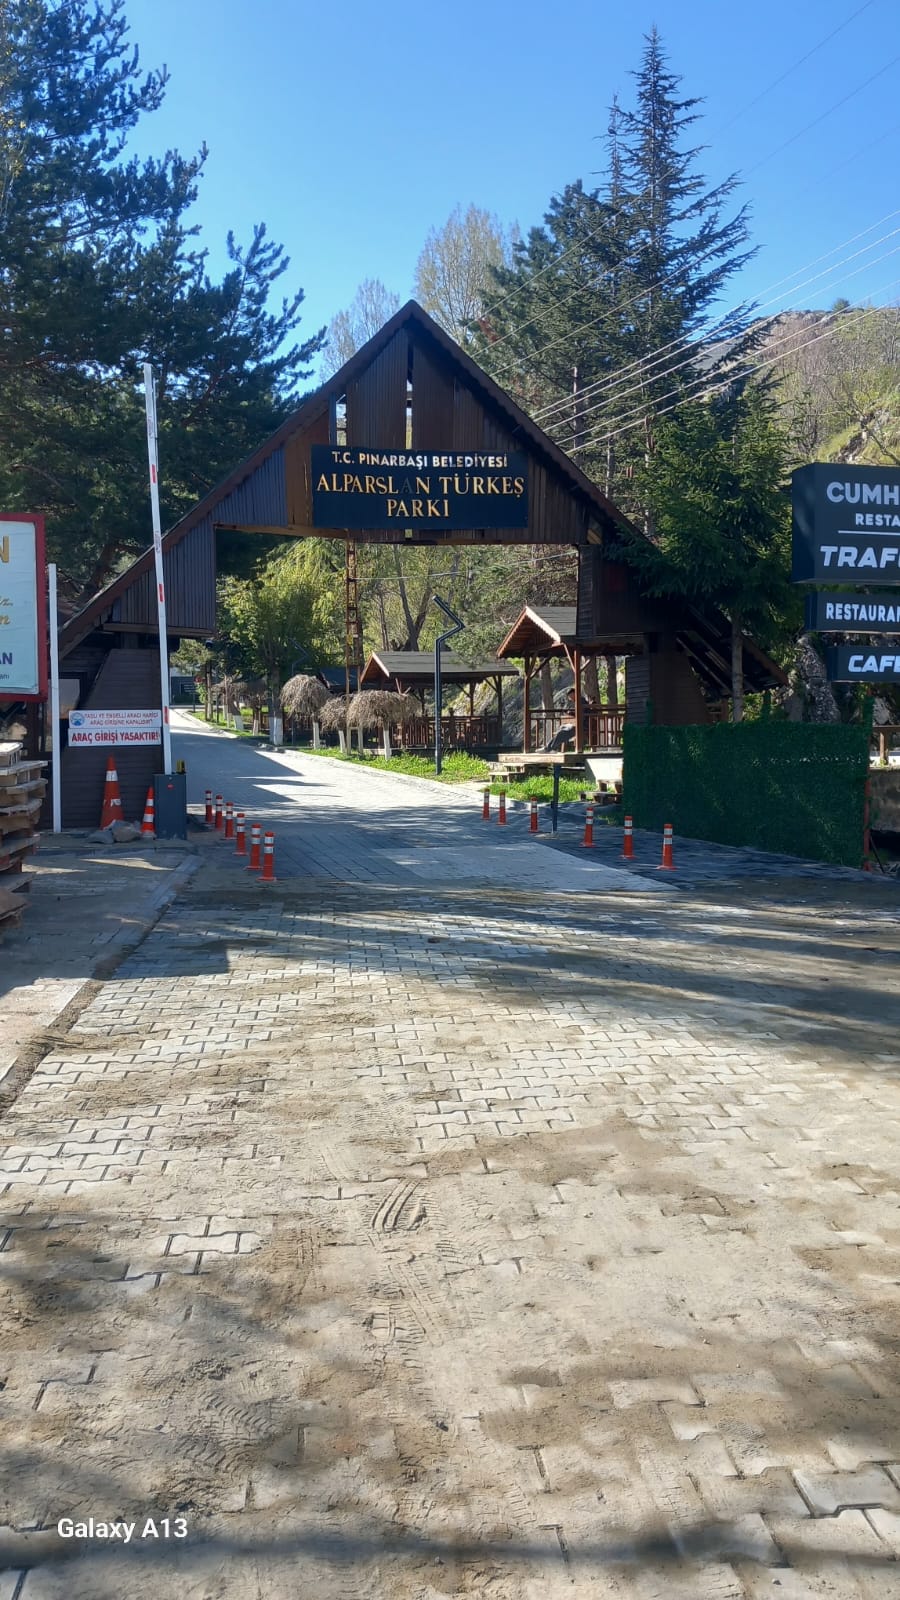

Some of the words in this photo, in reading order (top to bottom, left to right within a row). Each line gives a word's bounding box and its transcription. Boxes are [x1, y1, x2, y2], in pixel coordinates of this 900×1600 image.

[332, 451, 355, 464] T.C.
[359, 452, 428, 470] PINARBAŞI
[432, 453, 508, 468] BELEDİYESİ
[316, 473, 430, 494] ALPARSLAN
[439, 472, 525, 498] TÜRKEŞ
[826, 481, 900, 505] CUMH
[386, 499, 450, 517] PARKI
[820, 545, 900, 569] TRAF
[72, 733, 93, 744] ARAÇ
[94, 730, 118, 744] GİRİŞİ
